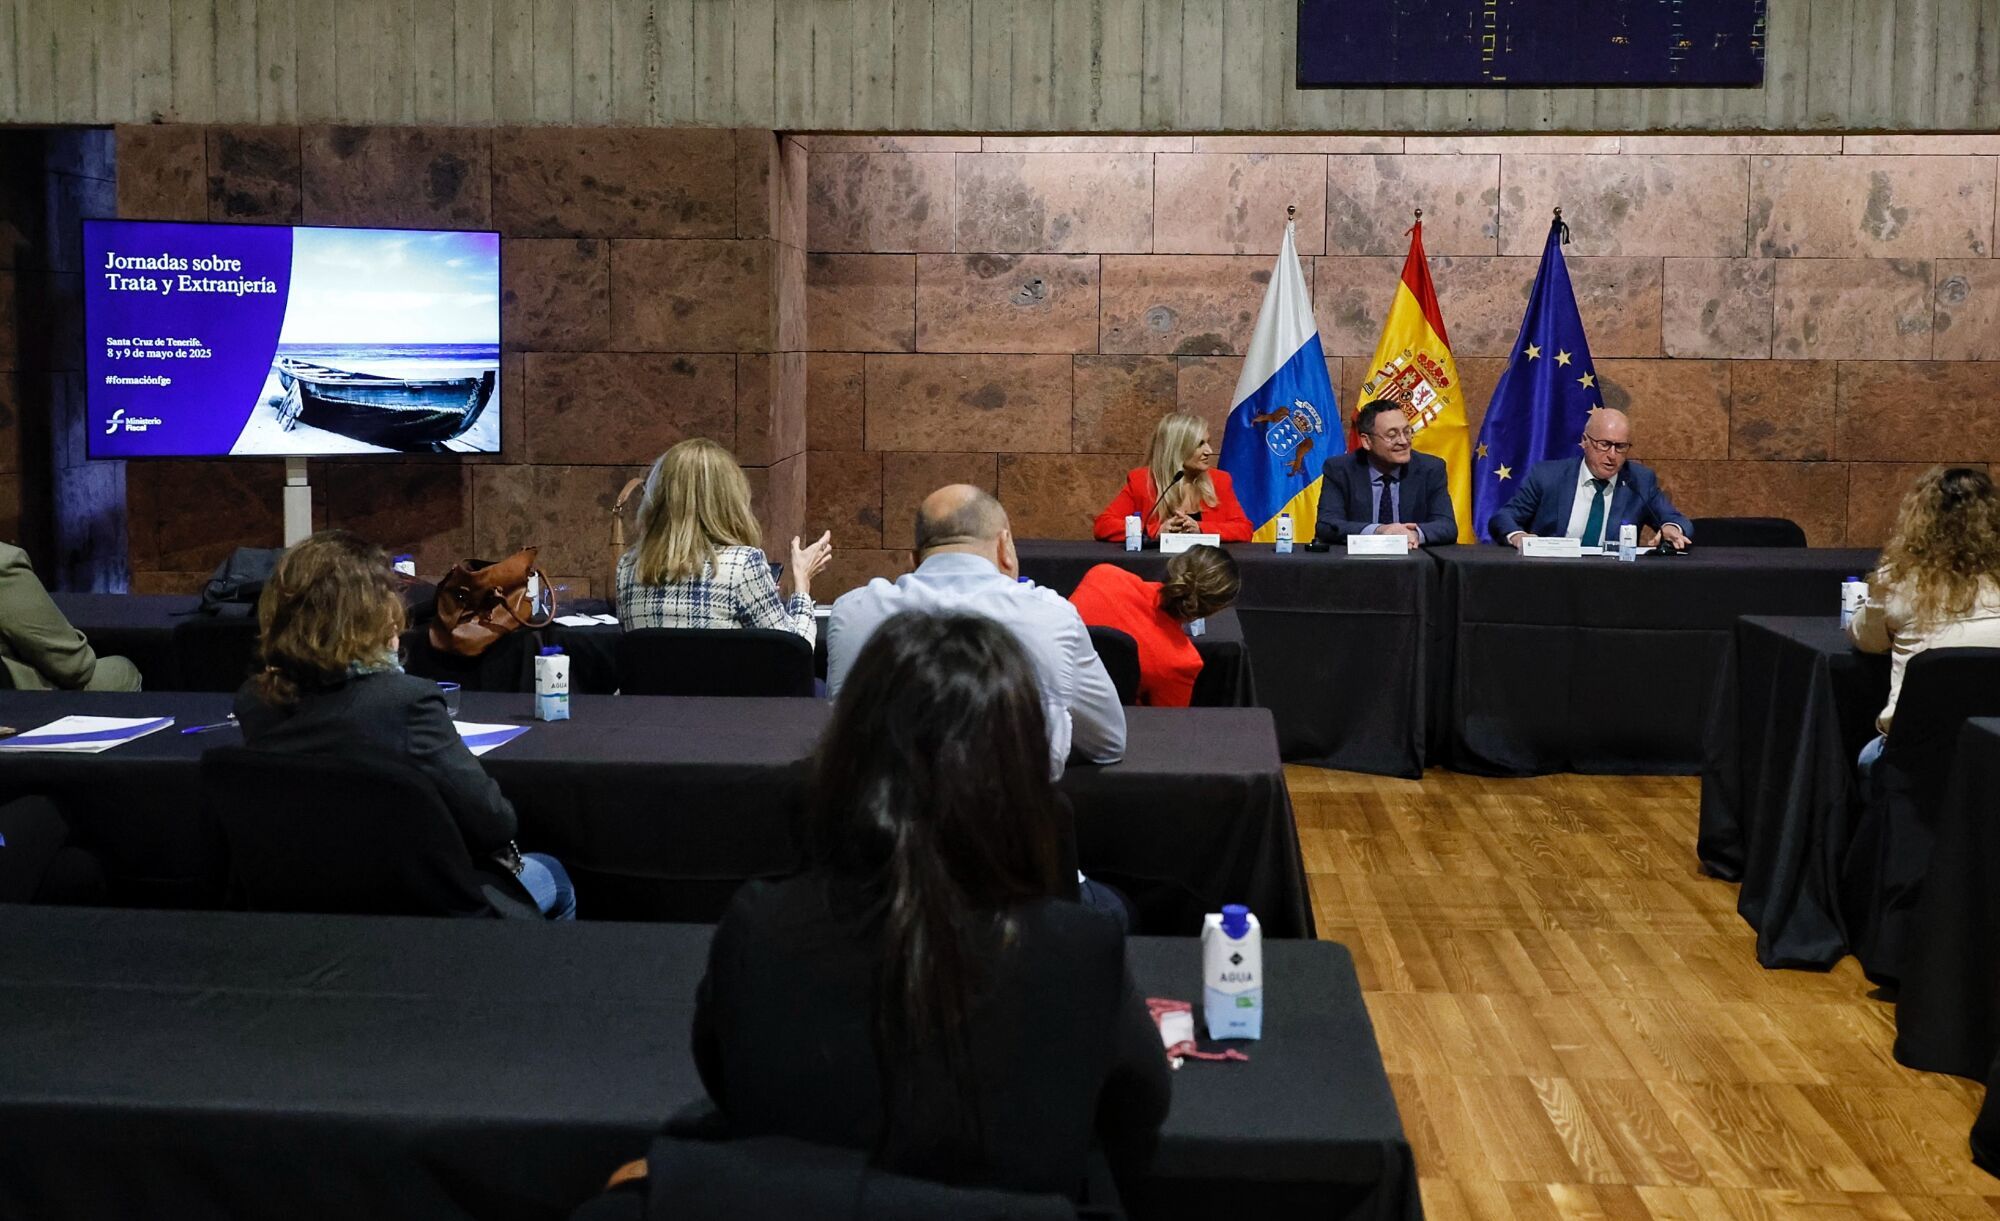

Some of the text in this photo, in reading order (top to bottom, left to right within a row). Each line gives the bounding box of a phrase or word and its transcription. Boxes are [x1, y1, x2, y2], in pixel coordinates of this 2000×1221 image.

[105, 252, 241, 272] Jornadas sobre
[105, 273, 277, 296] Trata y Extranjería
[106, 337, 131, 346] Santa
[132, 337, 154, 346] Cruz
[154, 338, 165, 346] de
[107, 348, 212, 360] 8 y 9 de mayo de 2025
[105, 375, 172, 387] #formaciónfge
[125, 417, 162, 425] Ministerio
[1220, 972, 1253, 982] AGUA
